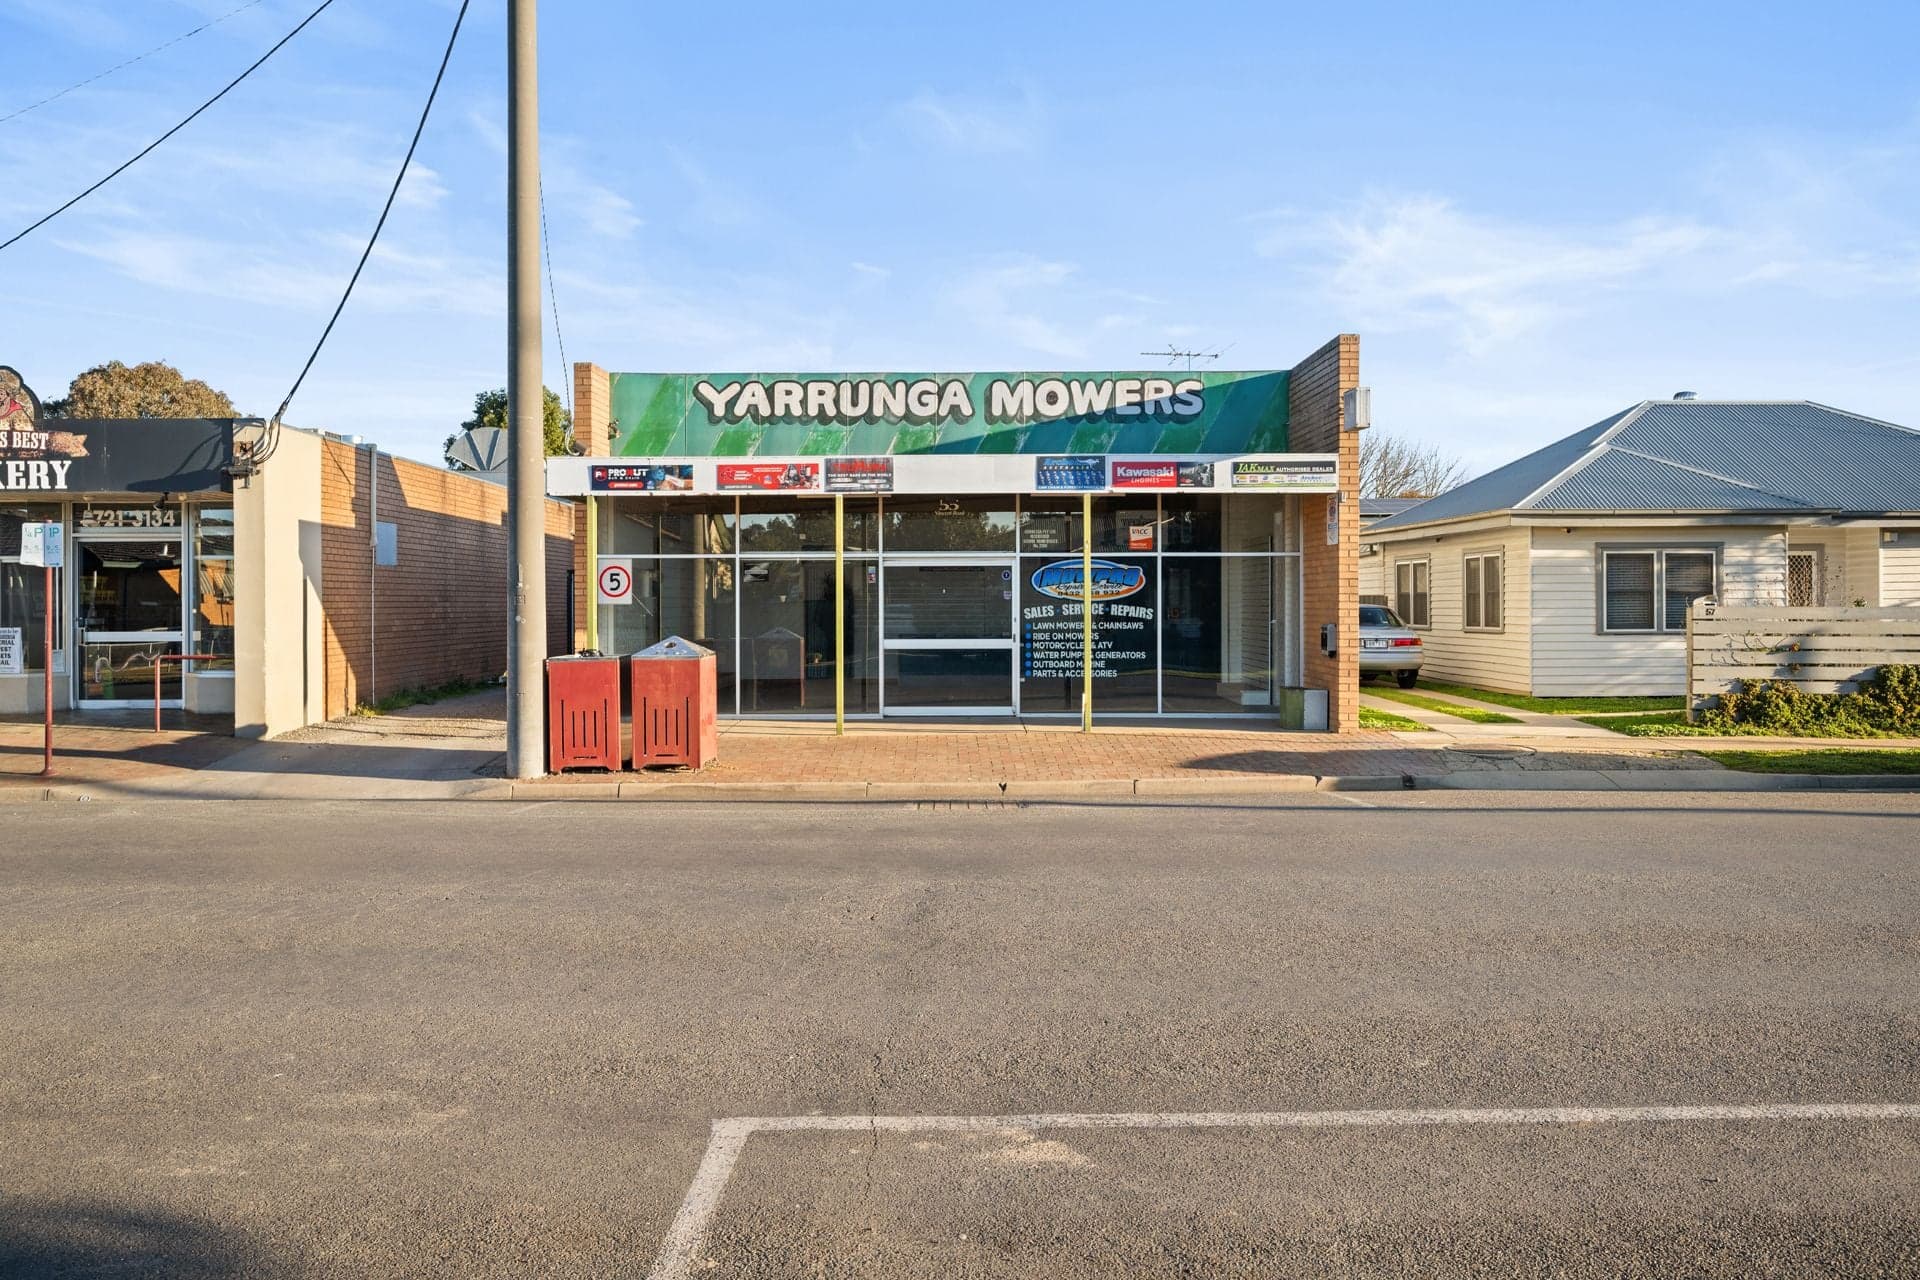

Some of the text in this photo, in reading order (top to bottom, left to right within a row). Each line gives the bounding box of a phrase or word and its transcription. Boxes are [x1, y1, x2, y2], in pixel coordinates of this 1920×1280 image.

[695, 378, 1204, 420] YARRUNGA MOWERS
[12, 431, 48, 449] BEST
[0, 460, 72, 490] ERY
[1117, 466, 1174, 477] Kawasaki
[609, 572, 621, 591] 5
[1024, 603, 1154, 620] SALES SERVCE REPAIRS
[1098, 621, 1144, 630] CHAINSAWS
[1033, 632, 1051, 640] RIDE
[1052, 632, 1064, 640] ON
[1033, 641, 1085, 649] MOTORCYCLE
[1098, 641, 1113, 649] ATV
[1033, 651, 1060, 659] WATER
[1060, 651, 1084, 659] PUMP
[1095, 651, 1146, 659] GENERATORS
[1033, 660, 1075, 668] OUTBOARD
[1033, 669, 1117, 677] PARTS & ACCESORIES
